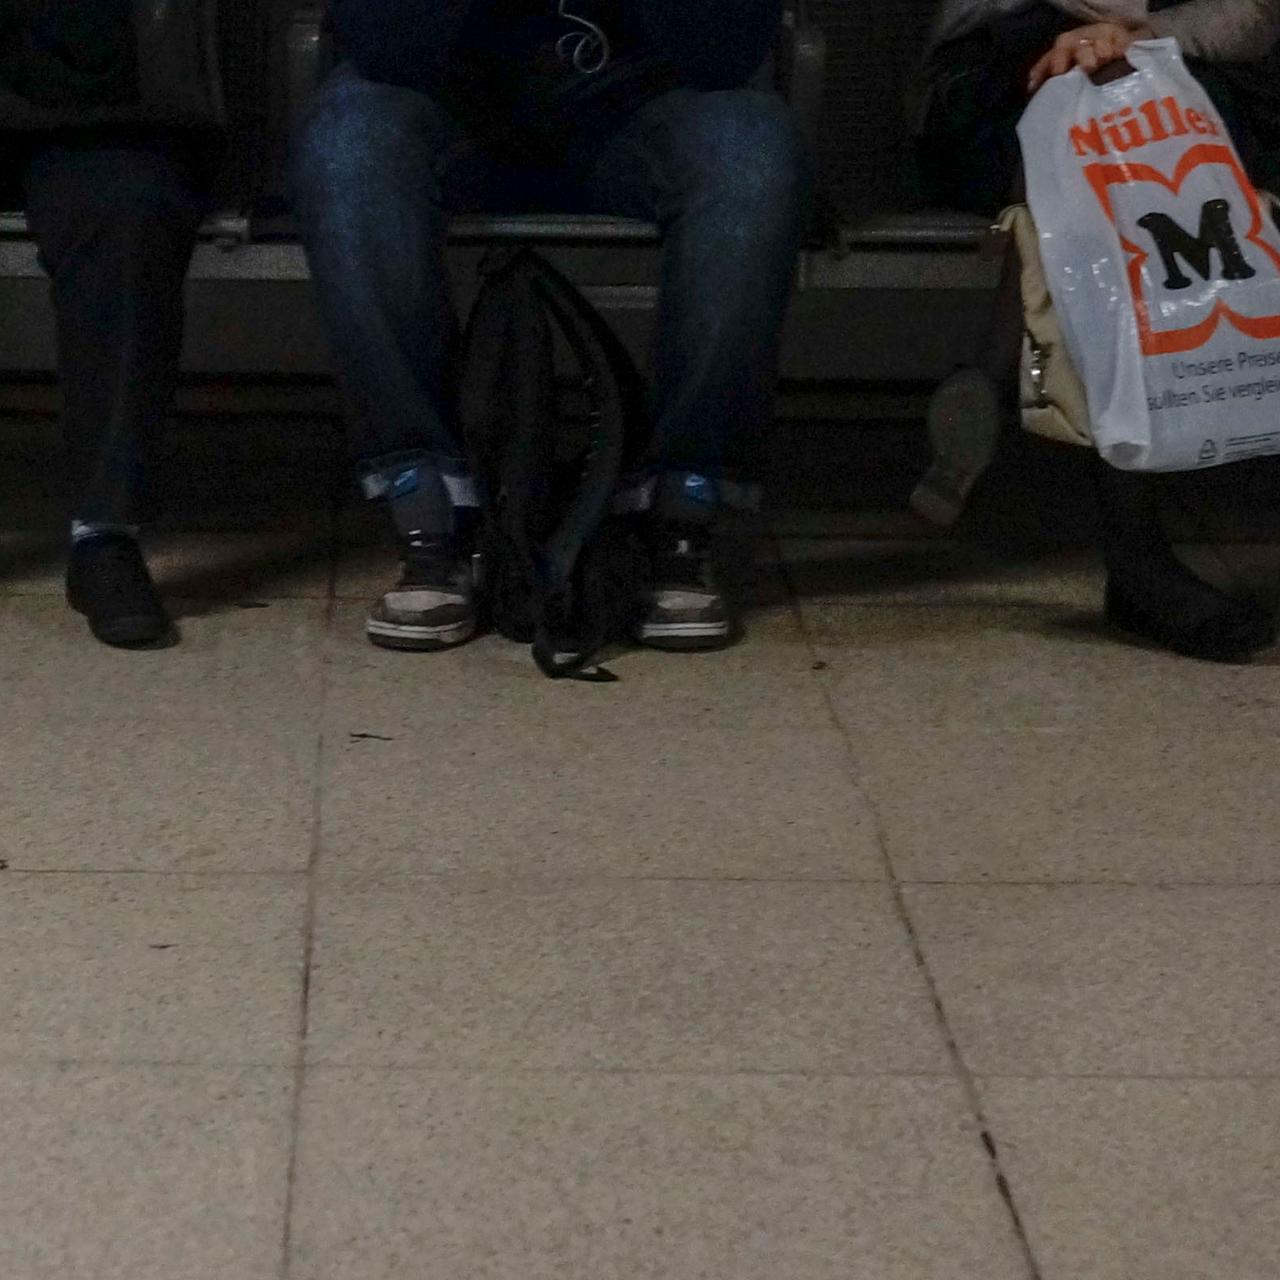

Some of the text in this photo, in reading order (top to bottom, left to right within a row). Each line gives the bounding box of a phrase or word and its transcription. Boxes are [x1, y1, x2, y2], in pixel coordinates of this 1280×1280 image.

[1136, 198, 1256, 290] M
[1171, 357, 1233, 380] Unsere
[1146, 387, 1197, 411] sollten
[1201, 384, 1226, 404] Sie
